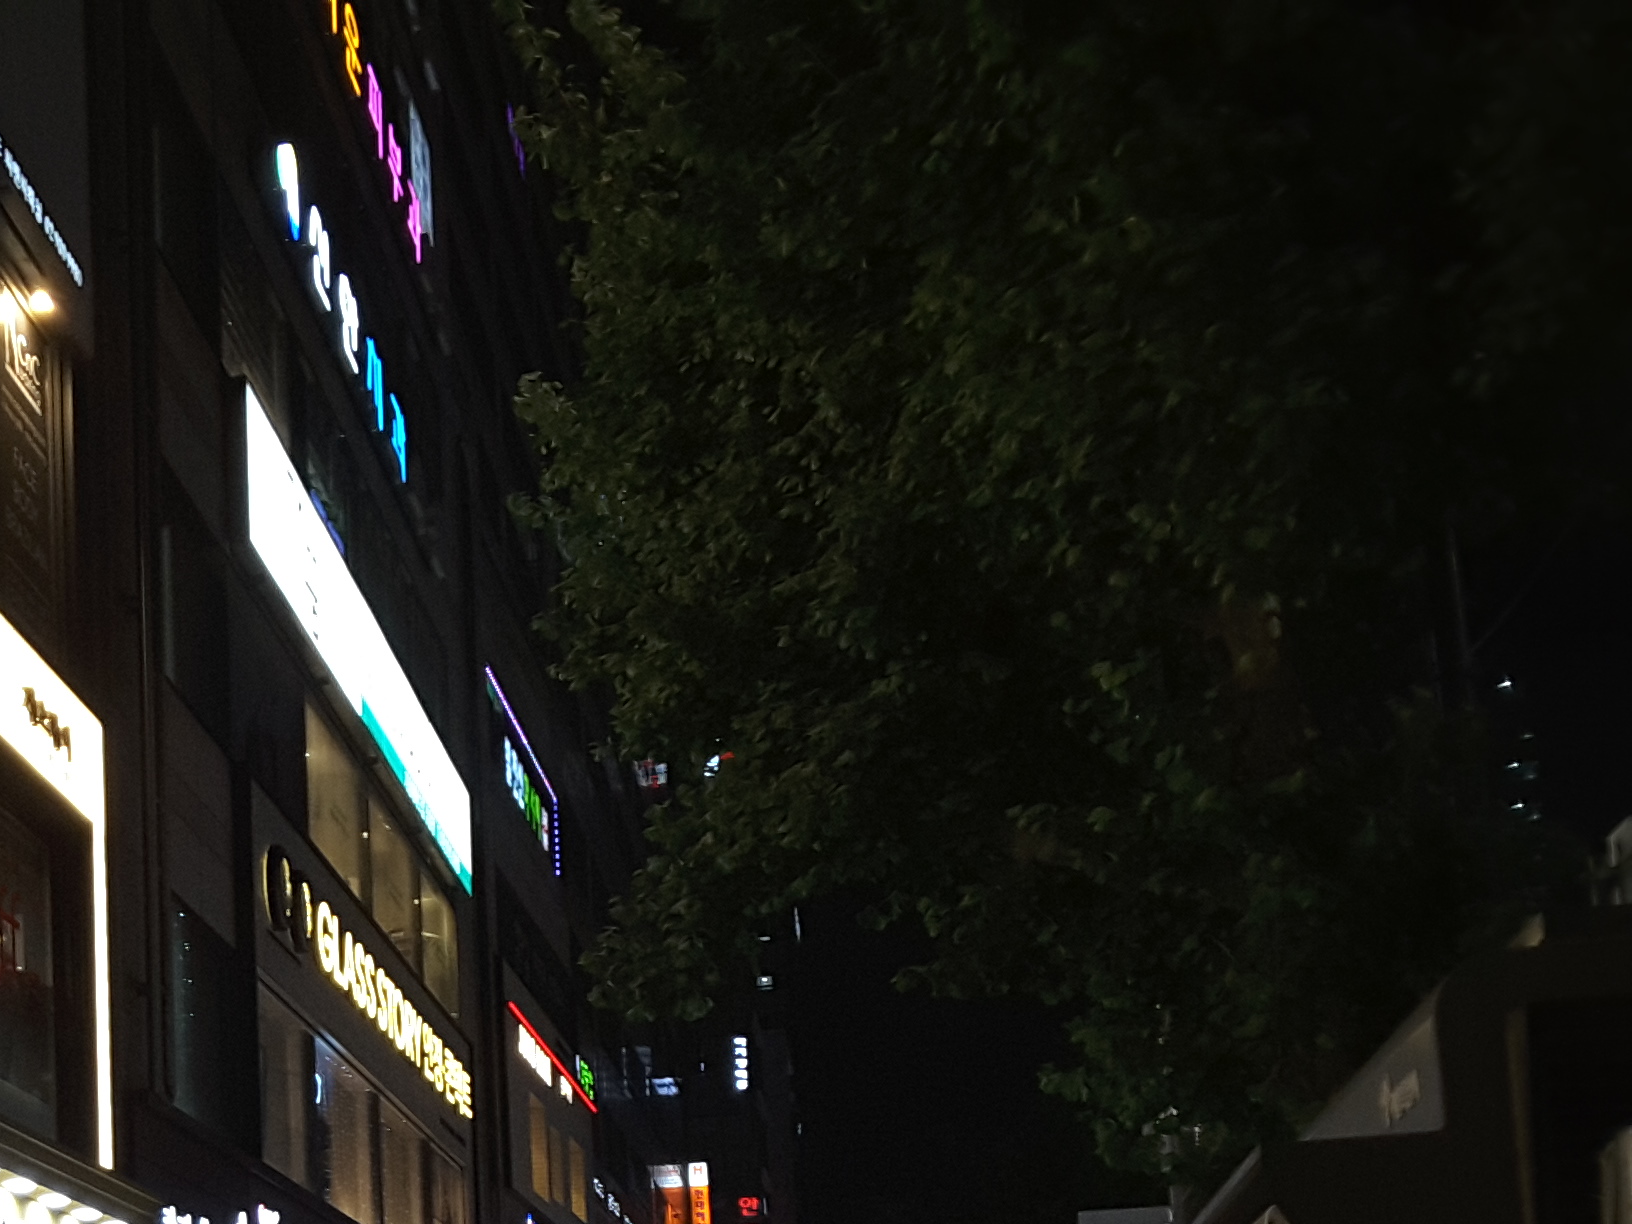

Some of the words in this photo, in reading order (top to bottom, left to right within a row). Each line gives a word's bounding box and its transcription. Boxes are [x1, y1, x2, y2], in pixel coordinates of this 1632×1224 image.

[318, 901, 376, 1019] GLASS
[376, 967, 422, 1068] STORY
[422, 1022, 445, 1093] 안경
